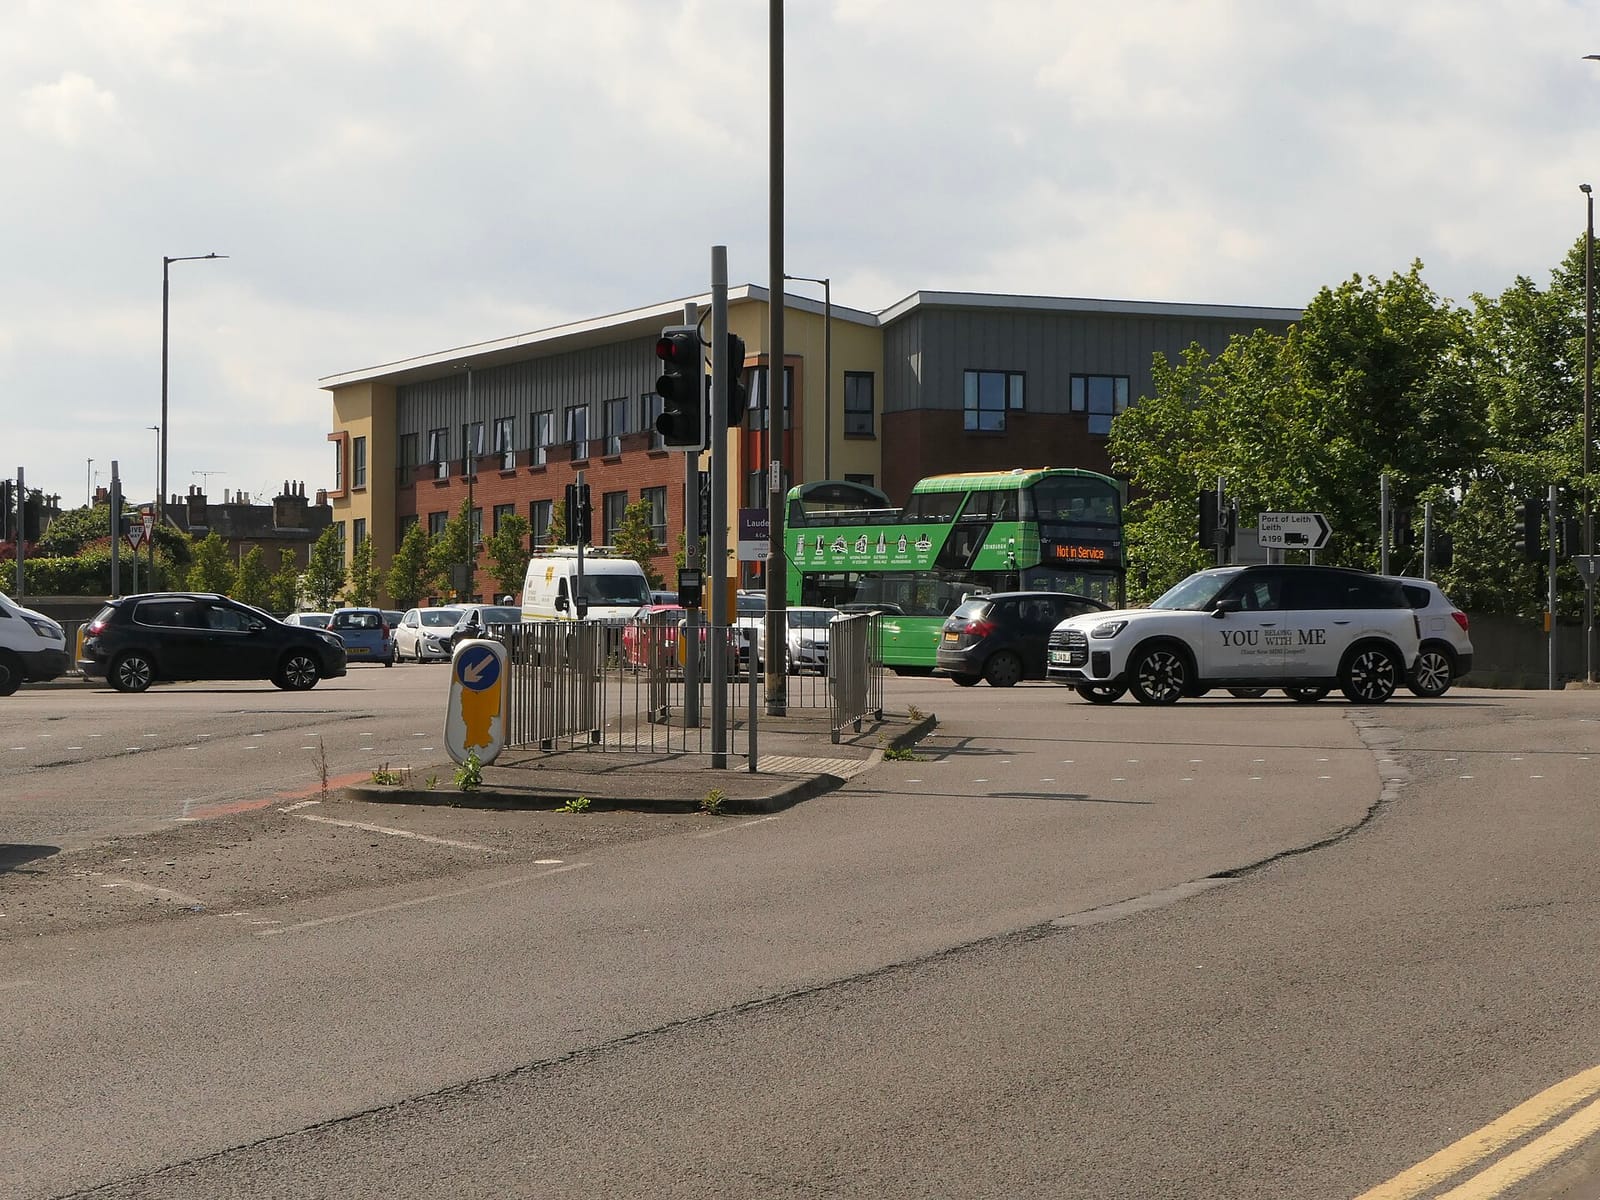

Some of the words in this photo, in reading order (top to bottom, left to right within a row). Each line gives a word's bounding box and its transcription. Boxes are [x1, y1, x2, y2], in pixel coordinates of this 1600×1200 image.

[1262, 515, 1279, 523] Port
[1281, 515, 1289, 523] of
[1292, 515, 1311, 523] Leith
[1056, 545, 1070, 558] Not
[1070, 545, 1077, 558] in
[1078, 546, 1105, 559] Service
[1220, 630, 1259, 647] YOU
[1264, 637, 1293, 646] WITH
[1298, 629, 1327, 646] ME
